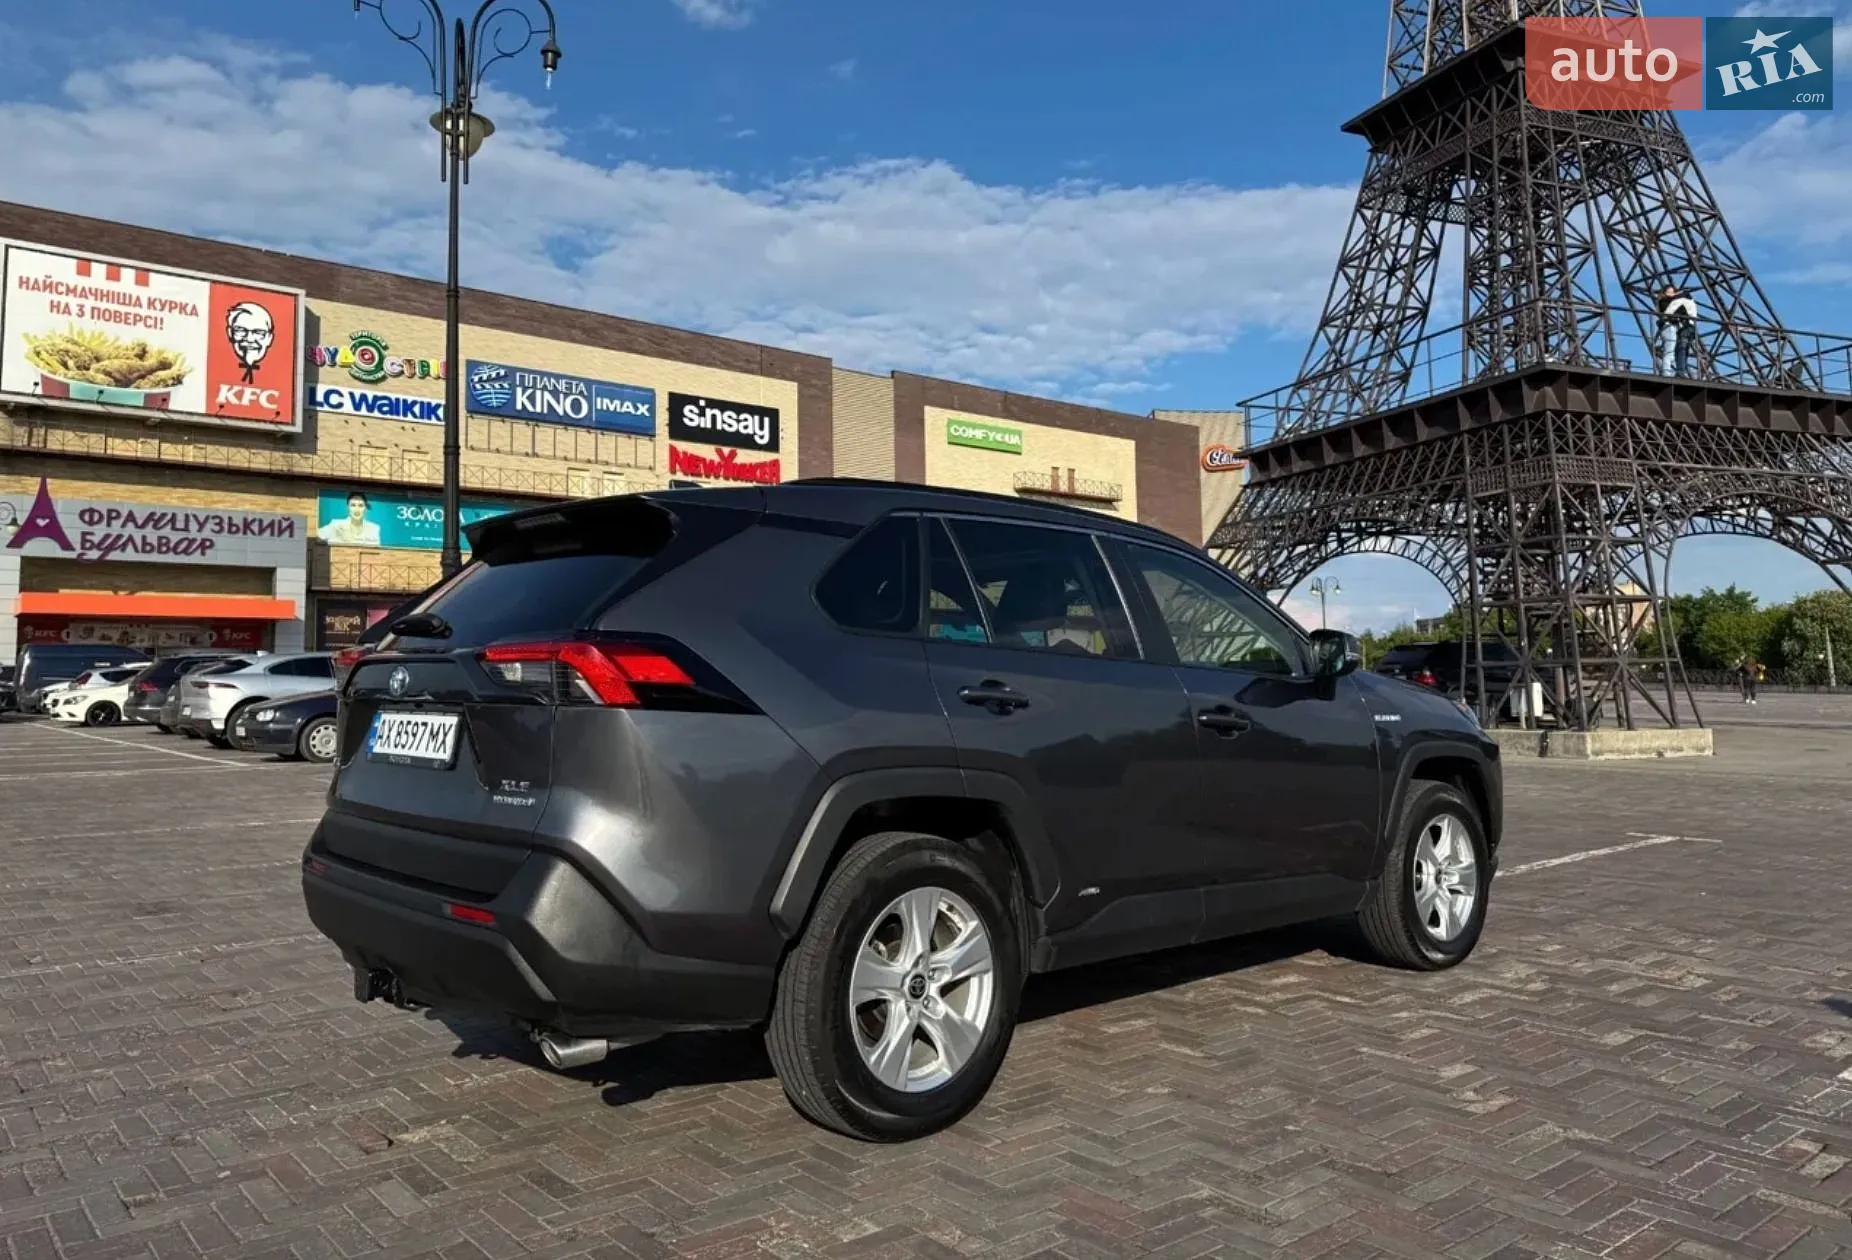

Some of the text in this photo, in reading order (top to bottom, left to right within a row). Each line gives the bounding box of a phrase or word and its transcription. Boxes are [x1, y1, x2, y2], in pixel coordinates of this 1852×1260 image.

[18, 275, 199, 317] НАЙСМАЧНІША КУРКА
[49, 299, 164, 330] НА 3 ПОВЕРСІ!
[217, 384, 280, 410] KFC
[308, 386, 345, 409] LC
[516, 387, 589, 419] KINO
[596, 397, 650, 417] IMAX
[682, 400, 770, 444] sinsay
[78, 507, 295, 538] ФРАНЦУЗЬКИЙ
[394, 720, 428, 751] 8597
[425, 722, 453, 754] MX
